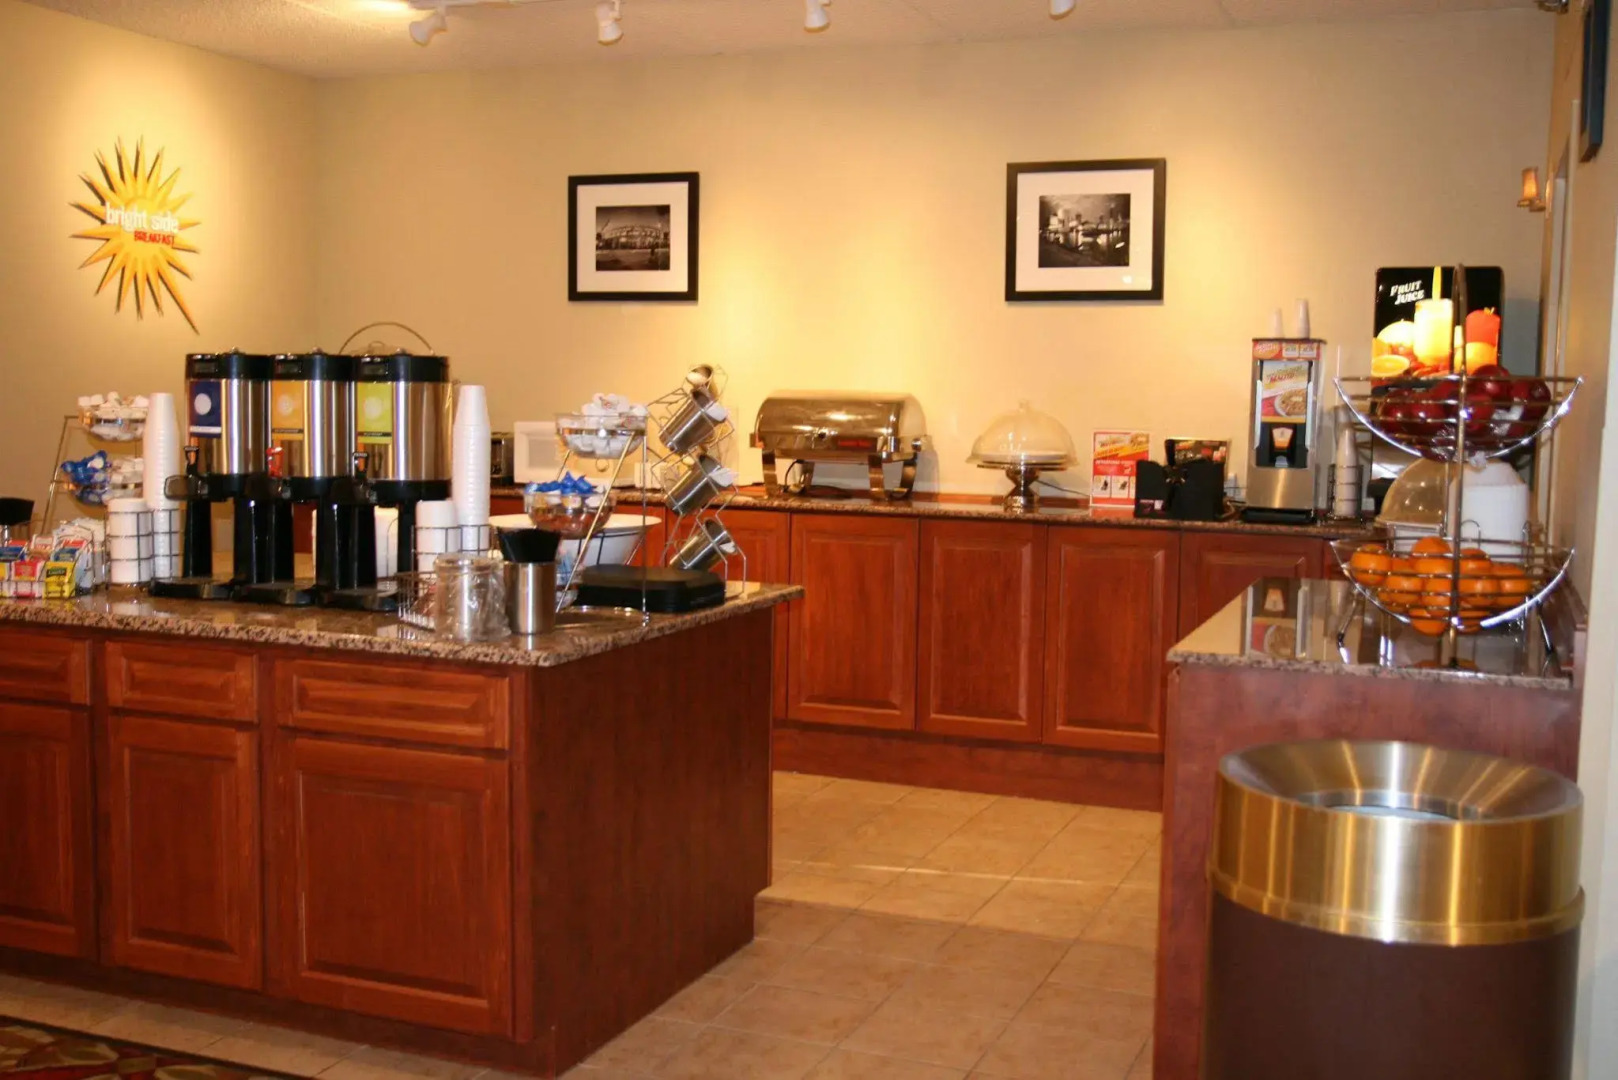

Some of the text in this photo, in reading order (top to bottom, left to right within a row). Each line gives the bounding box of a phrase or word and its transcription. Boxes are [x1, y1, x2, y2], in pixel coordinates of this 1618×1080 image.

[105, 202, 178, 233] bright side
[134, 230, 174, 245] BREAKFAST
[1390, 280, 1422, 296] FRUIT
[1394, 290, 1424, 305] JUICE
